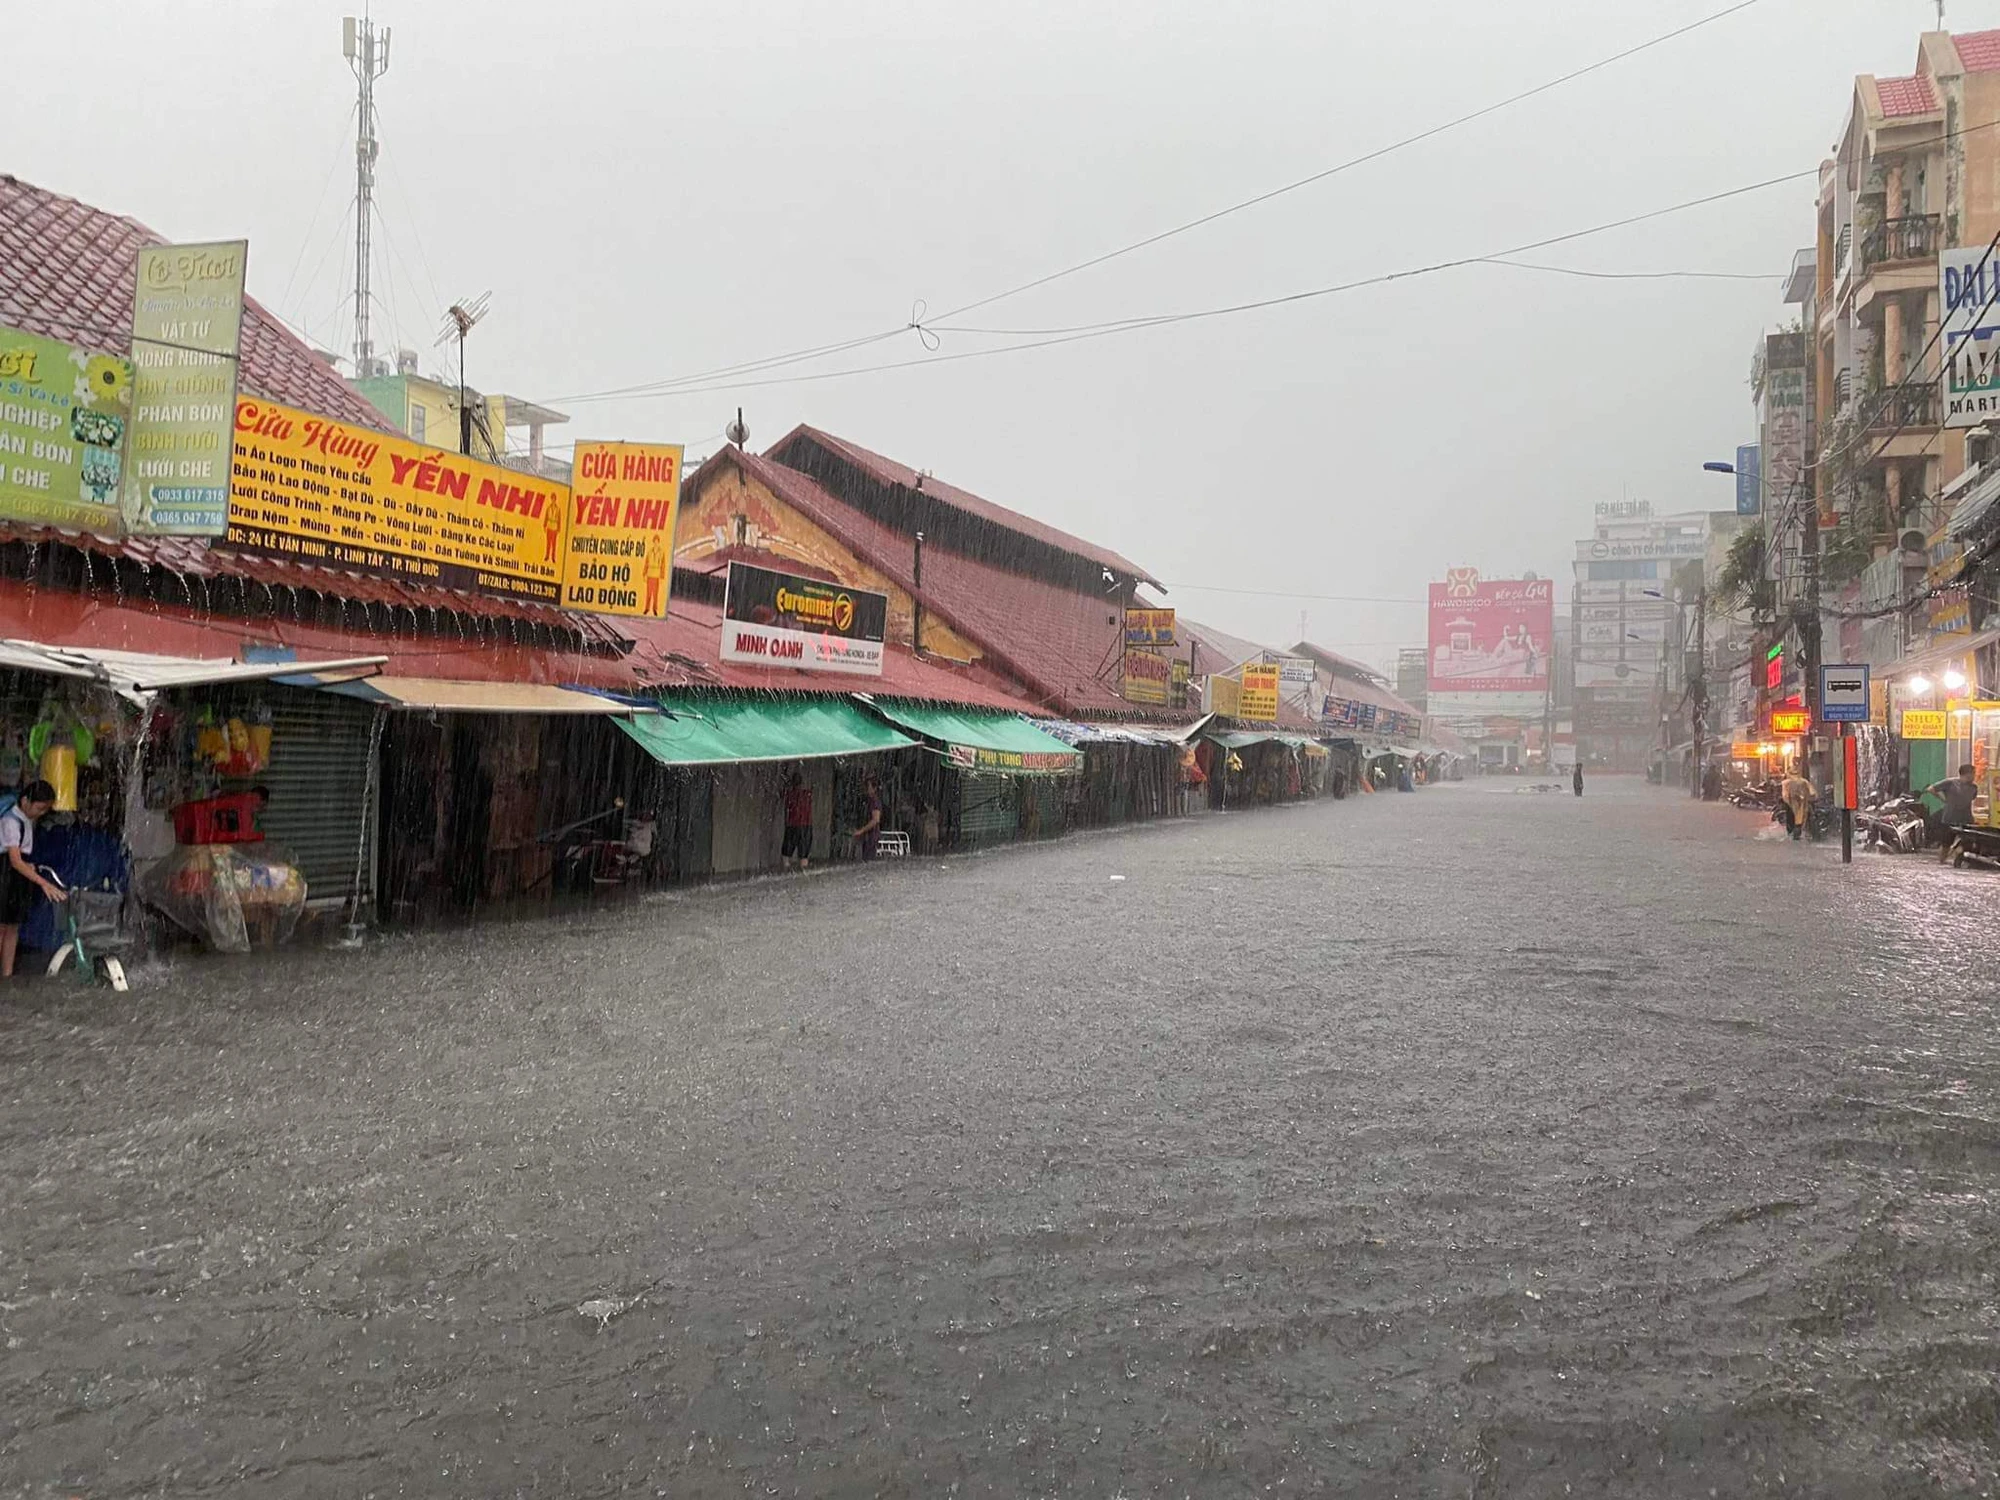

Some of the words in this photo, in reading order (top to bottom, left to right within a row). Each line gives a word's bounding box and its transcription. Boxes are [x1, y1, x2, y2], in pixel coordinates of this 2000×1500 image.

[189, 400, 225, 422] BÓN
[1950, 397, 1998, 415] MART
[180, 459, 212, 478] CHE
[234, 402, 293, 441] Cửa
[302, 419, 380, 469] Hàng
[390, 452, 470, 500] YẾN
[476, 478, 546, 519] NHI
[235, 443, 246, 457] In
[270, 451, 297, 469] Logo
[300, 458, 326, 475] Theo
[581, 444, 617, 480] CỬA
[622, 450, 674, 484] HÀNG
[12, 467, 51, 490] CHE
[233, 462, 256, 479] Bảo
[260, 469, 276, 486] Hộ
[279, 473, 299, 488] Lao
[302, 479, 330, 496] Động
[341, 487, 358, 503] Bạt
[158, 488, 182, 501] 0933
[575, 482, 622, 527] YẾN
[624, 498, 670, 531] NHI
[261, 489, 290, 507] Công
[294, 496, 321, 513] Trình
[364, 511, 377, 524] Pe
[479, 535, 495, 549] Các
[230, 503, 258, 520] Drap
[262, 509, 288, 527] Nệm
[300, 517, 330, 535] Mùng
[482, 553, 493, 565] Và
[264, 532, 277, 549] LÊ
[301, 540, 326, 558] NINH
[345, 548, 365, 564] LINH
[571, 534, 599, 554] CHUYÊN
[600, 538, 619, 555] CUNG
[579, 558, 608, 580] BẢO
[612, 562, 630, 586] HỘ
[568, 586, 594, 604] LAO
[598, 585, 637, 609] ĐỘNG
[735, 633, 769, 656] MINH
[771, 638, 804, 660] OANH
